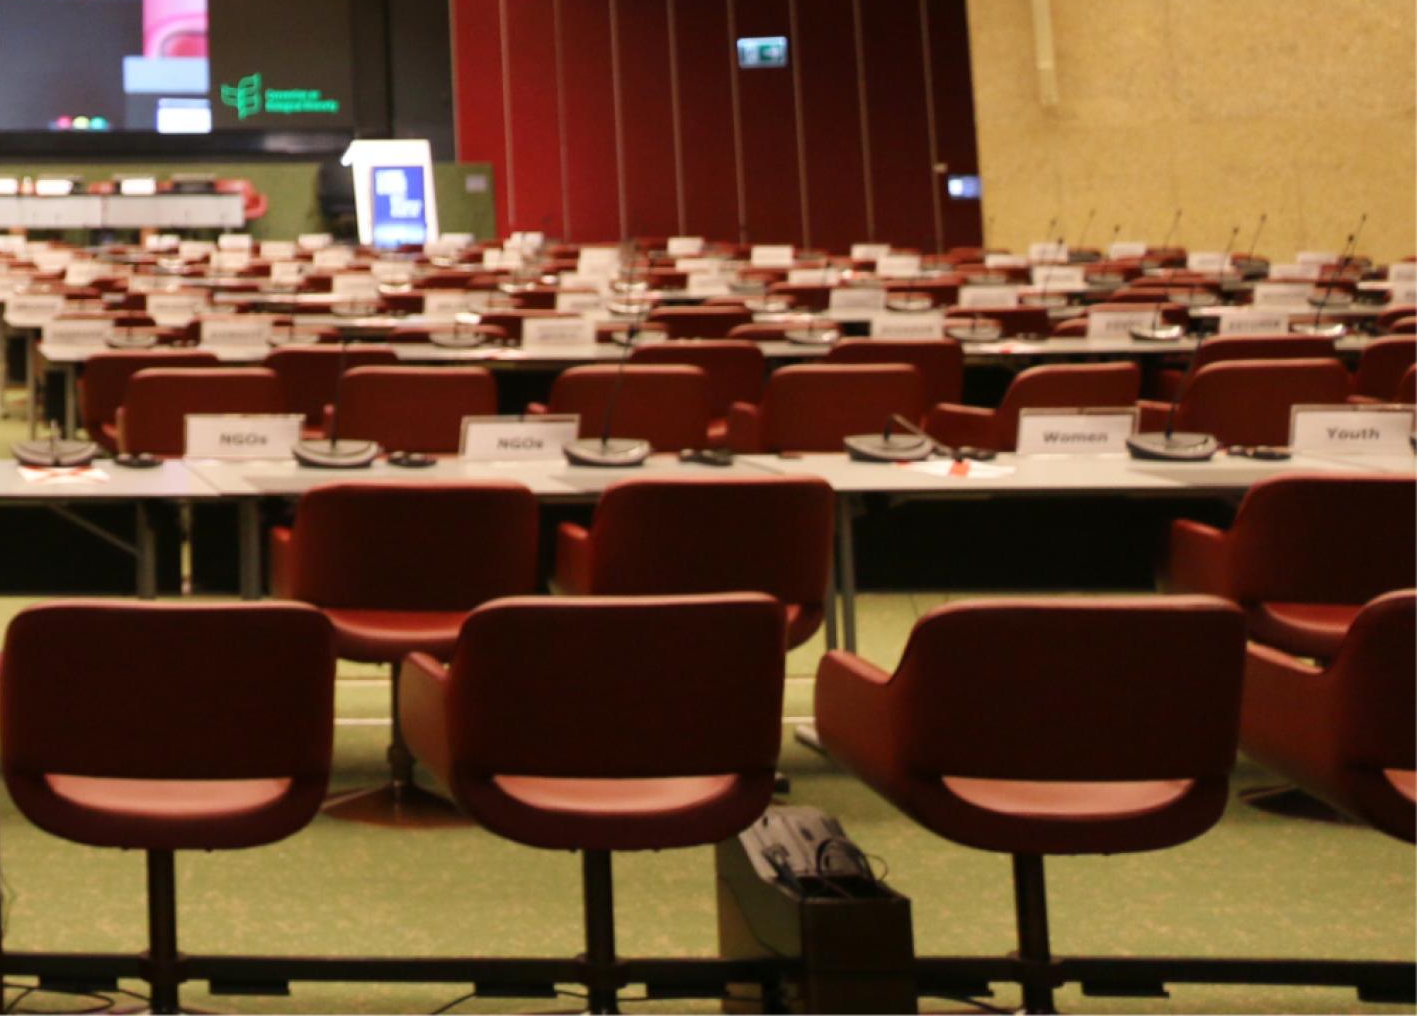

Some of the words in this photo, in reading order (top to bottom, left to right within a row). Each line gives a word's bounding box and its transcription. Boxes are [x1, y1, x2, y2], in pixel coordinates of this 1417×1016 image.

[218, 432, 268, 446] NGOs
[1042, 430, 1109, 444] Women
[1325, 426, 1380, 441] Youth
[496, 436, 543, 451] NGOs
